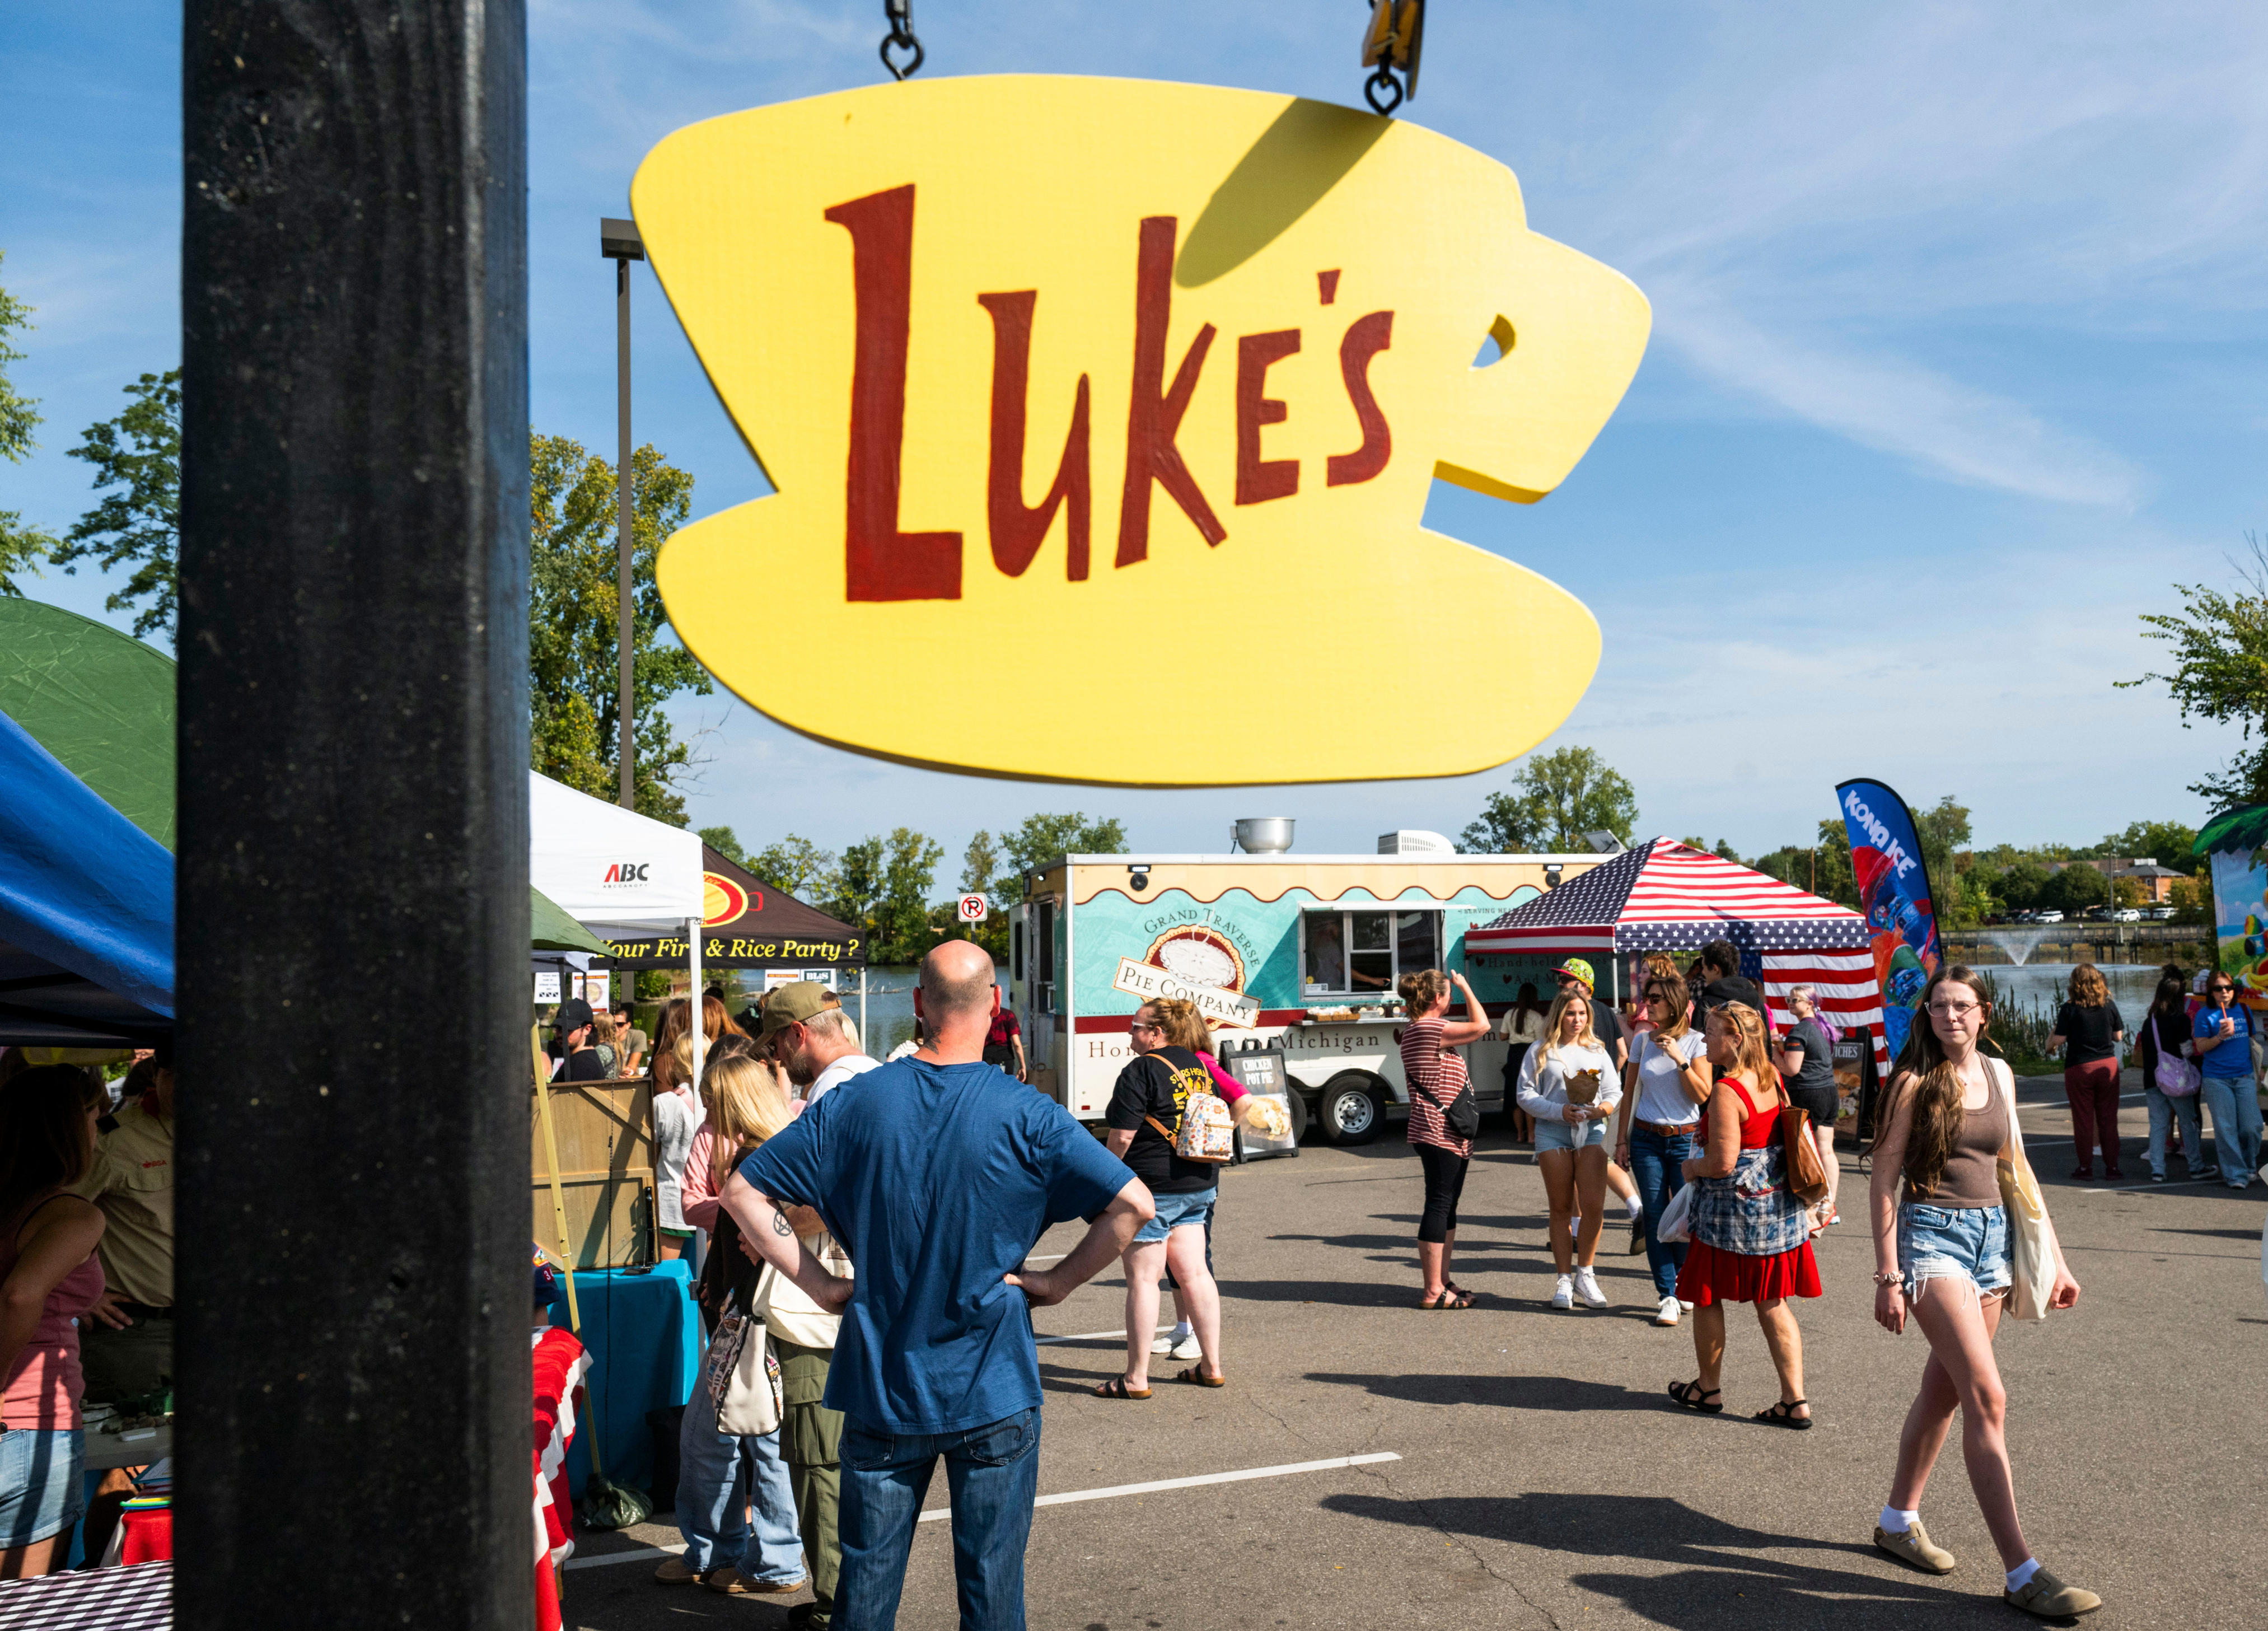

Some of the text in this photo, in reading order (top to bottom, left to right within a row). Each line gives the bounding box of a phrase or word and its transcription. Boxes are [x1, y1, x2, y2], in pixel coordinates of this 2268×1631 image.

[1845, 789, 1917, 880] KONA ICE
[604, 863, 649, 882] ABC
[1144, 908, 1260, 968] GRAND TRAVERSE
[654, 938, 690, 957] Fir
[705, 938, 725, 957] &
[729, 939, 775, 957] Rice
[780, 940, 841, 961] Party
[848, 939, 859, 956] ?
[1122, 967, 1252, 1020] PIE COMPANY
[1278, 1031, 1380, 1053] Michigan
[1242, 1058, 1273, 1071] CHICKEN
[1170, 1068, 1191, 1085] STRS
[1245, 1072, 1274, 1085] POT PIE
